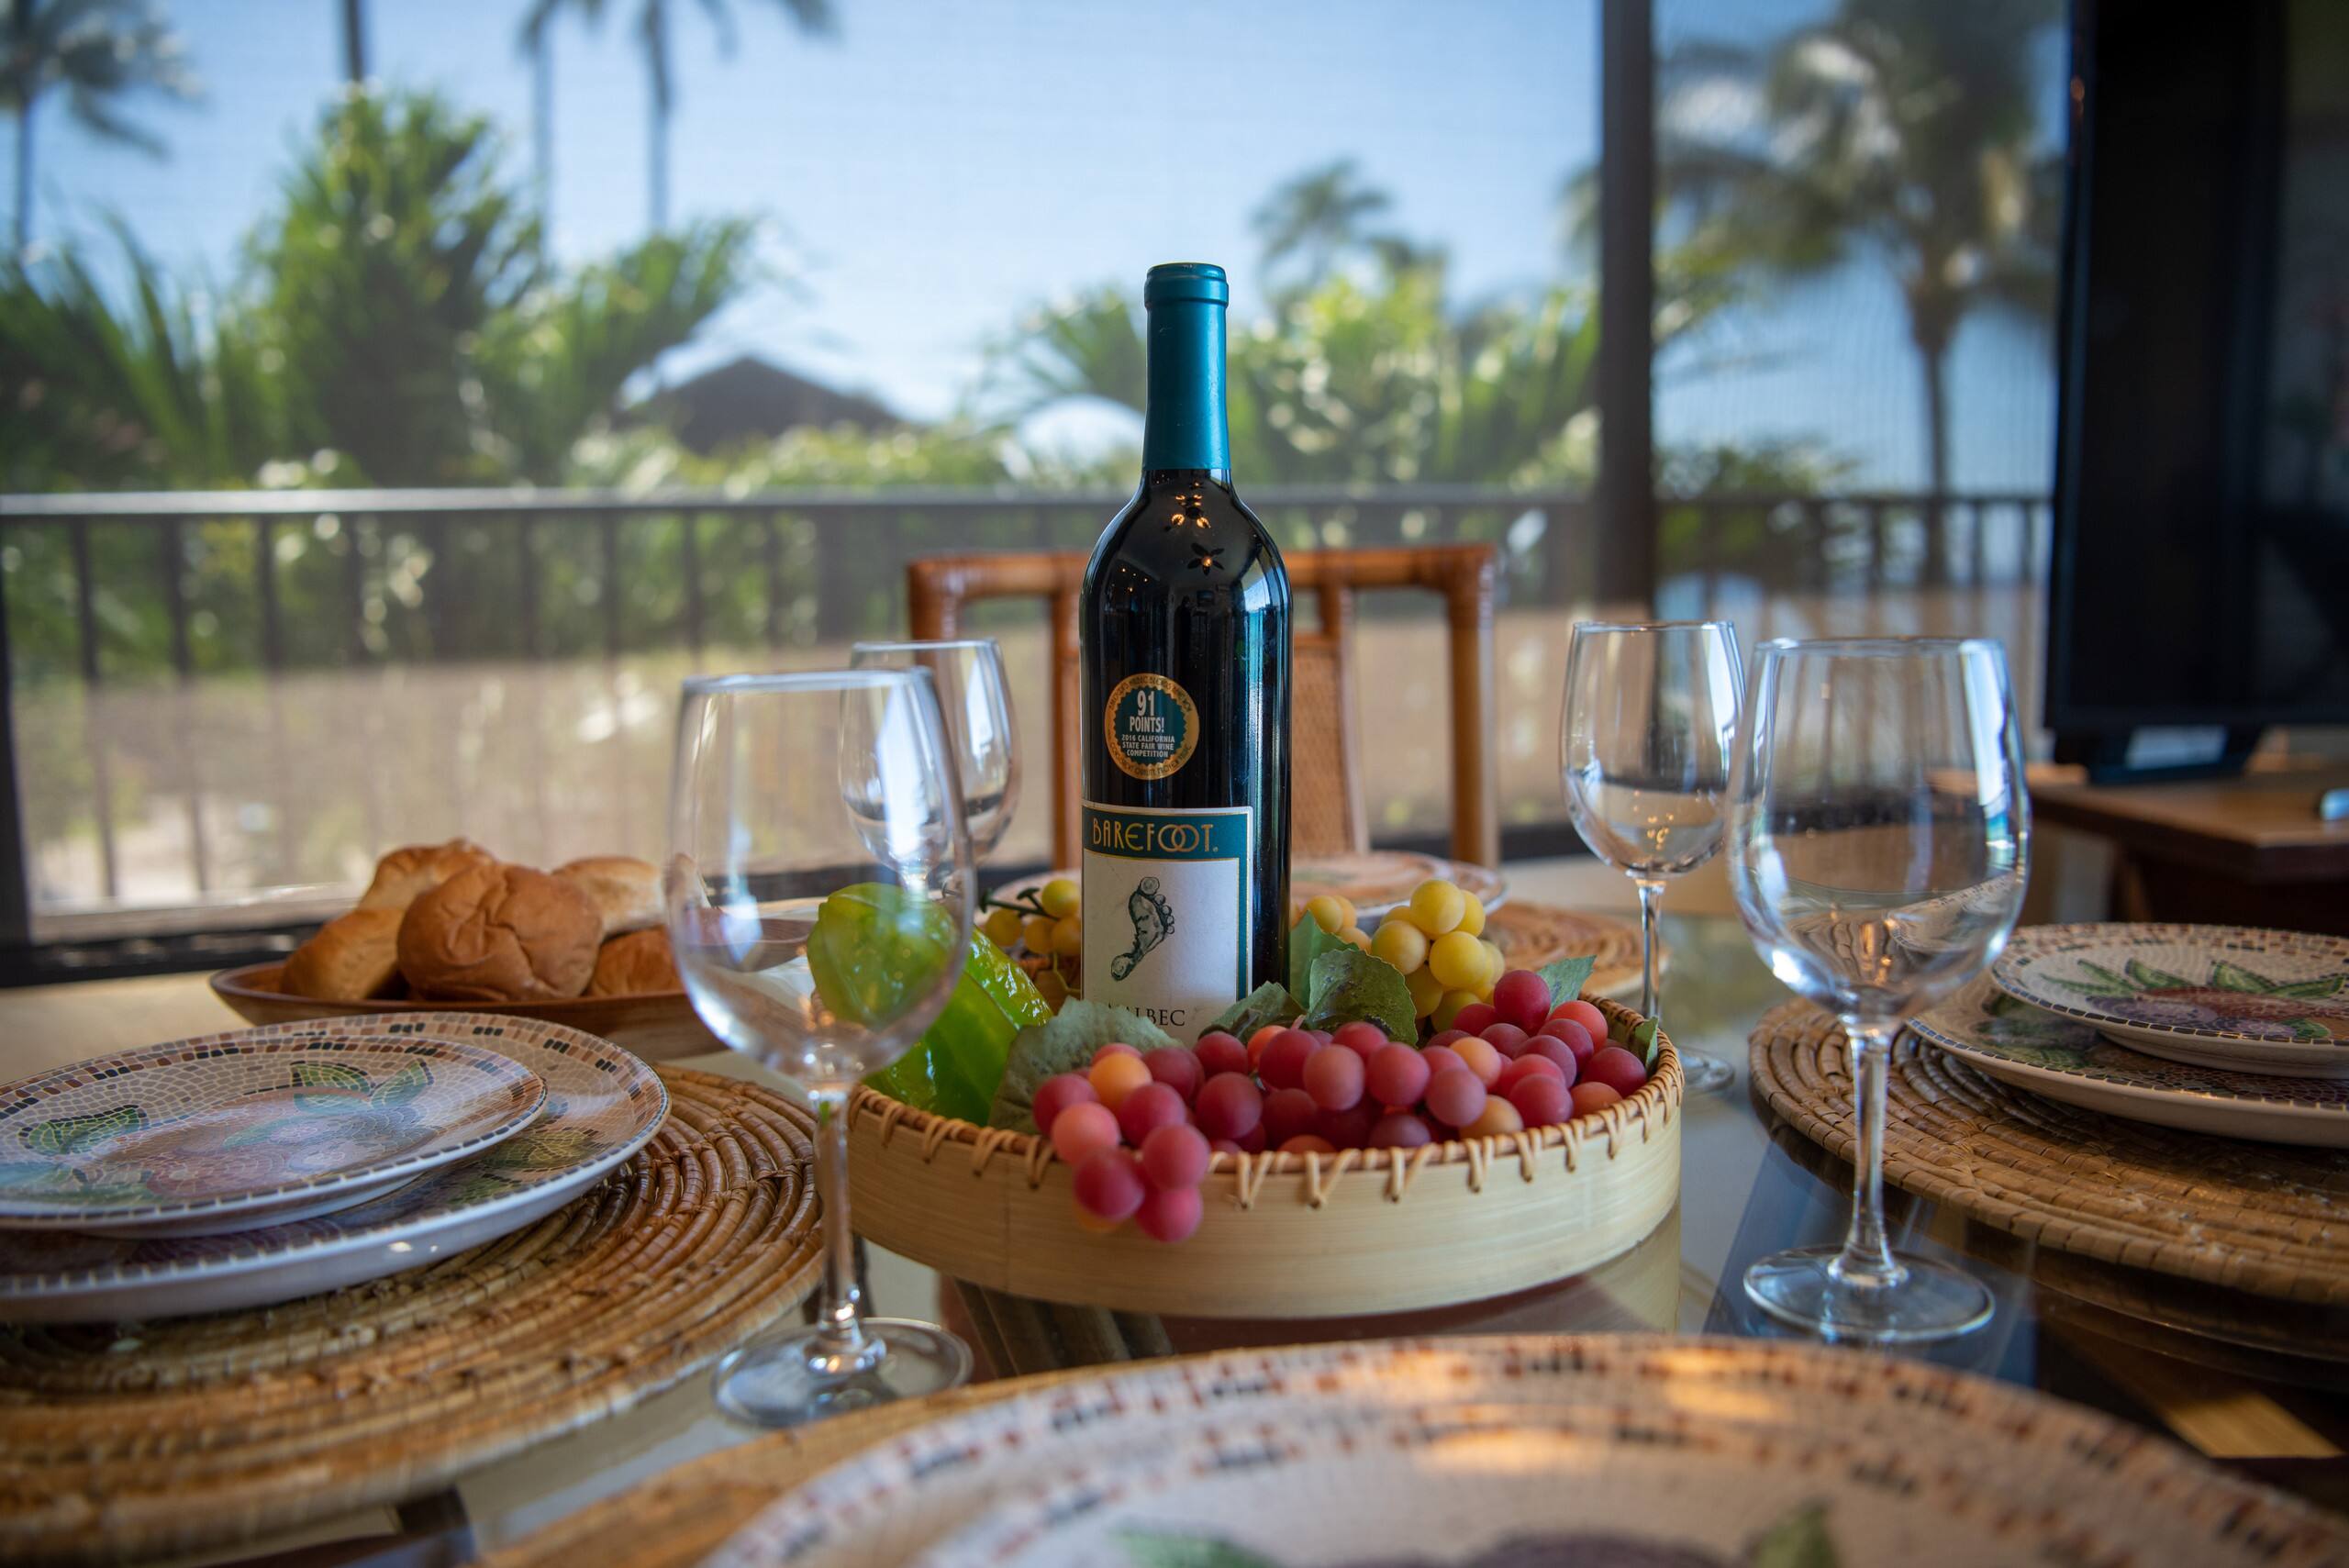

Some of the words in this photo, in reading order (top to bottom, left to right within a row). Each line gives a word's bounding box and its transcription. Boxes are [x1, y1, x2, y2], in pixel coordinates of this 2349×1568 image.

[1137, 690, 1155, 717] 91
[1130, 717, 1165, 733] POINTS!
[1138, 735, 1175, 743] CALIFORNIA
[1126, 750, 1169, 758] COMPETITION
[1093, 817, 1214, 852] BAREFOOT
